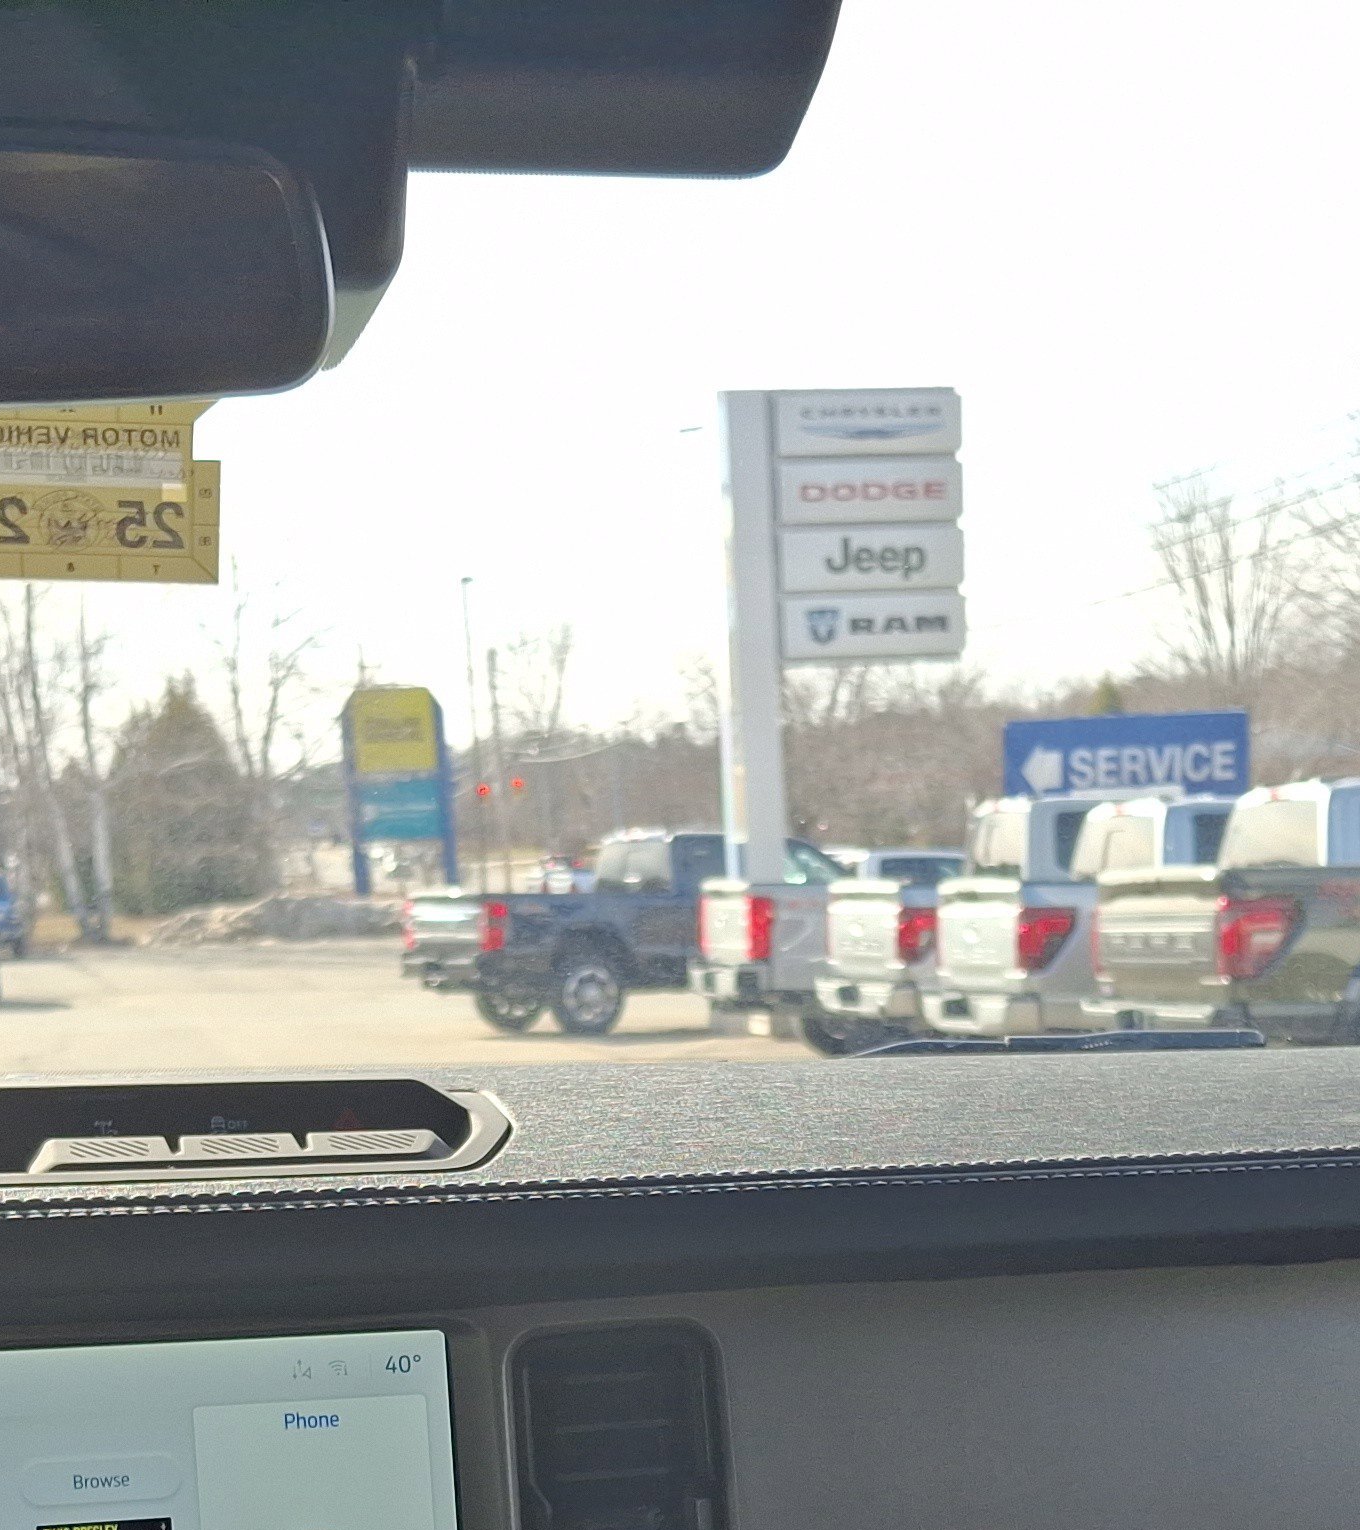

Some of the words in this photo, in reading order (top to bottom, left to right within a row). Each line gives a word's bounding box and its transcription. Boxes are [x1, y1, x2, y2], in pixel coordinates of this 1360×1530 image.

[800, 481, 946, 502] DODGE
[825, 537, 926, 580] Jeep
[849, 615, 948, 635] RAM
[1069, 742, 1237, 788] SERVICE
[385, 1354, 422, 1375] 40°
[284, 1411, 340, 1429] Phone
[72, 1471, 130, 1490] Browse
